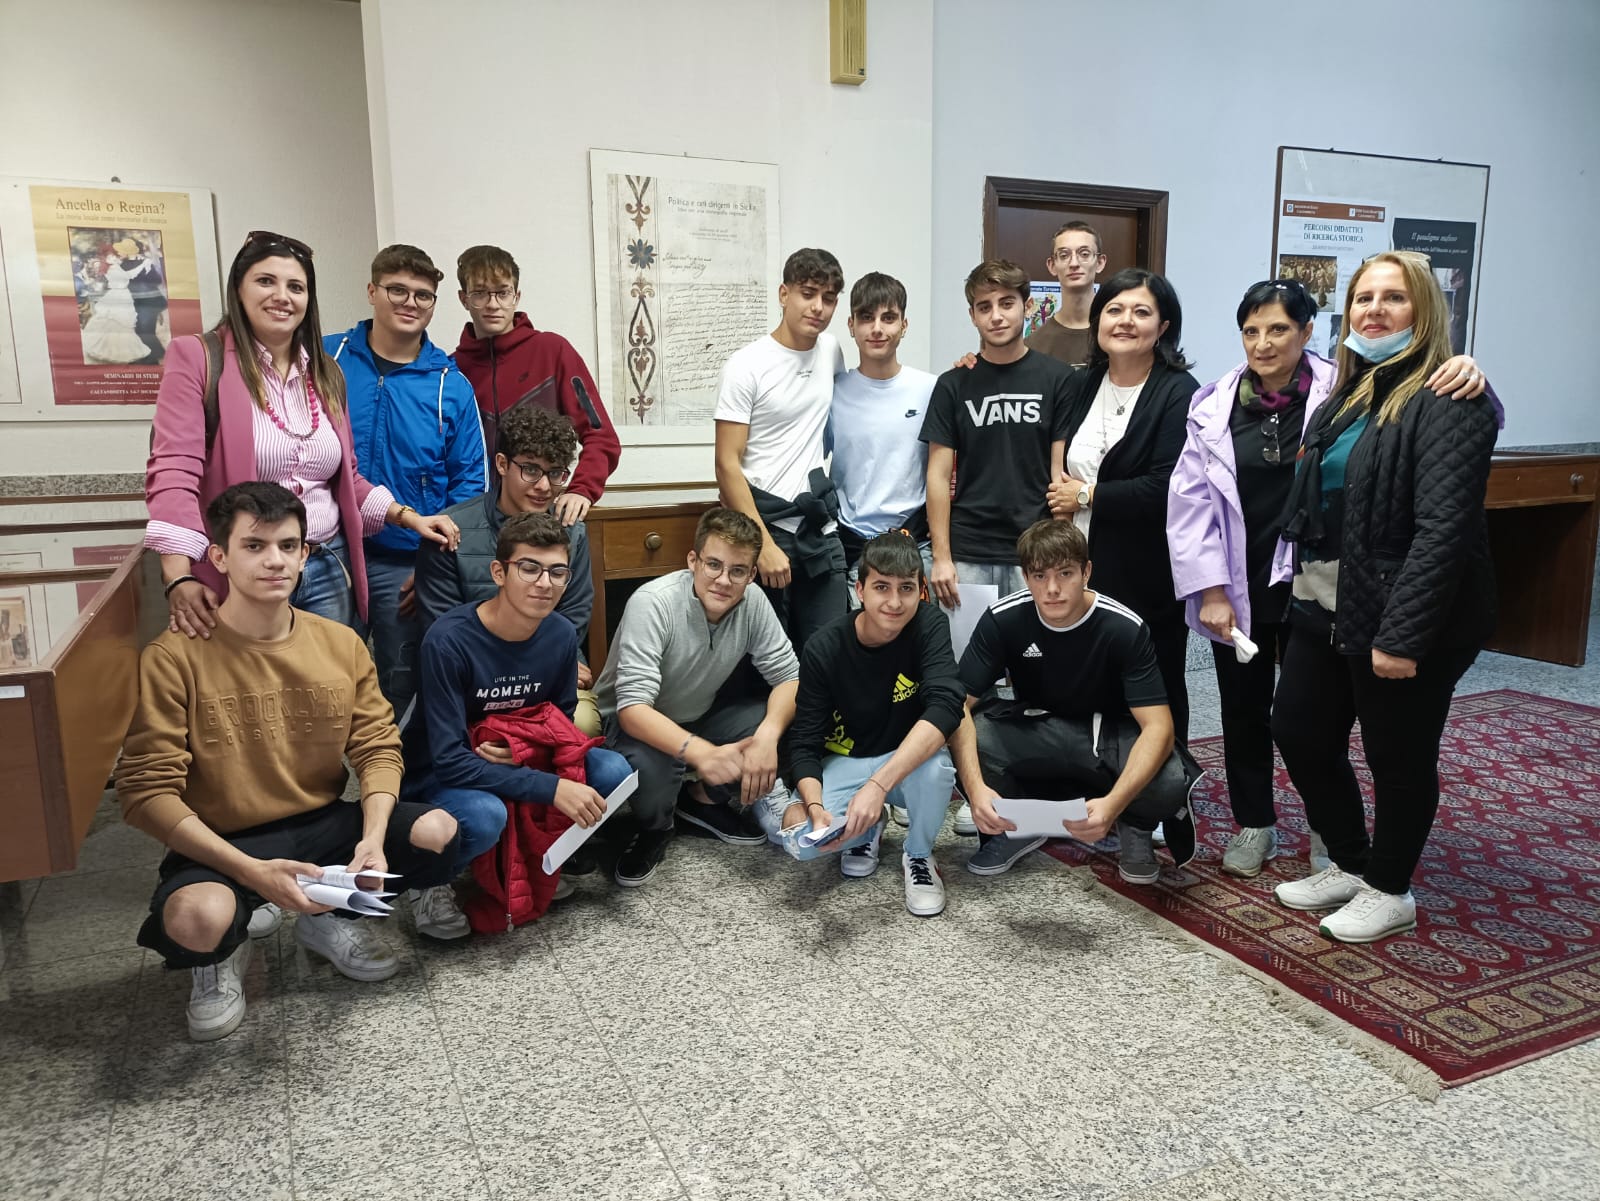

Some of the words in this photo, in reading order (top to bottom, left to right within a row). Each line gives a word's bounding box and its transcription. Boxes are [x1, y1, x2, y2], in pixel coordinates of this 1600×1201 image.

[56, 197, 101, 212] Ancella
[106, 203, 114, 212] o
[120, 200, 165, 216] Regina?
[1304, 223, 1333, 232] PERCORSI
[1333, 225, 1364, 234] DIDATTICI
[1303, 232, 1311, 240] DI
[1312, 233, 1338, 242] RICERCA
[1339, 234, 1364, 243] STORICA
[965, 393, 1043, 427] VANS
[476, 683, 542, 699] MOMENT
